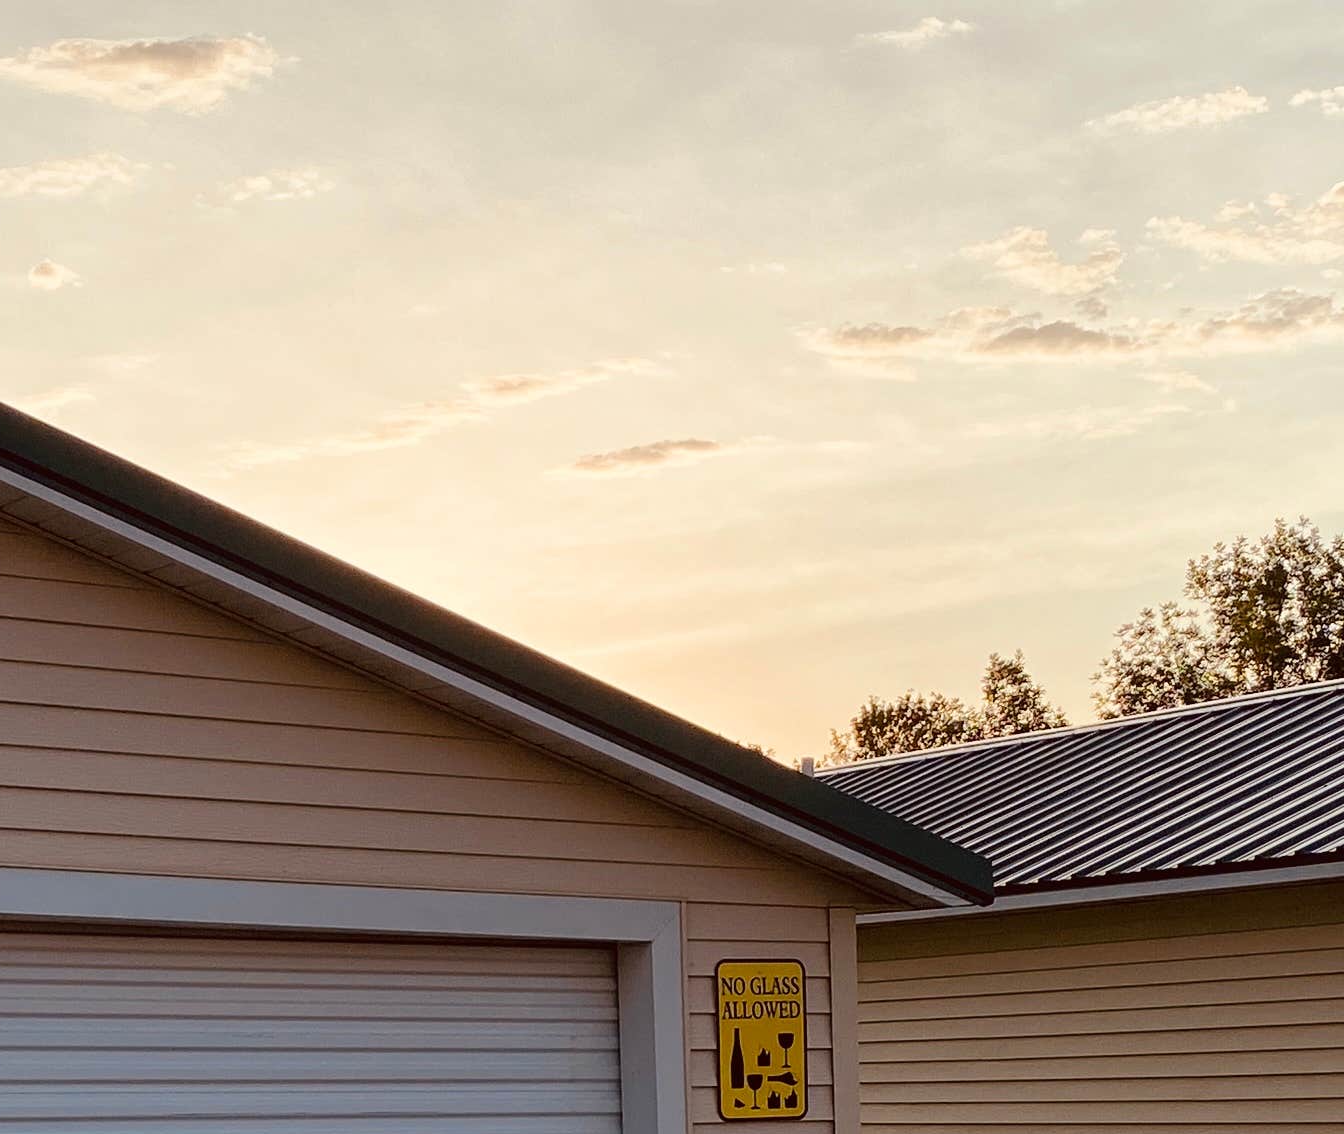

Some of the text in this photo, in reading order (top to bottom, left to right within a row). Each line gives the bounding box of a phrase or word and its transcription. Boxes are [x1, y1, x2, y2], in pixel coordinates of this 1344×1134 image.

[721, 976, 800, 996] NO GLASS
[722, 1000, 801, 1020] ALLOWED
